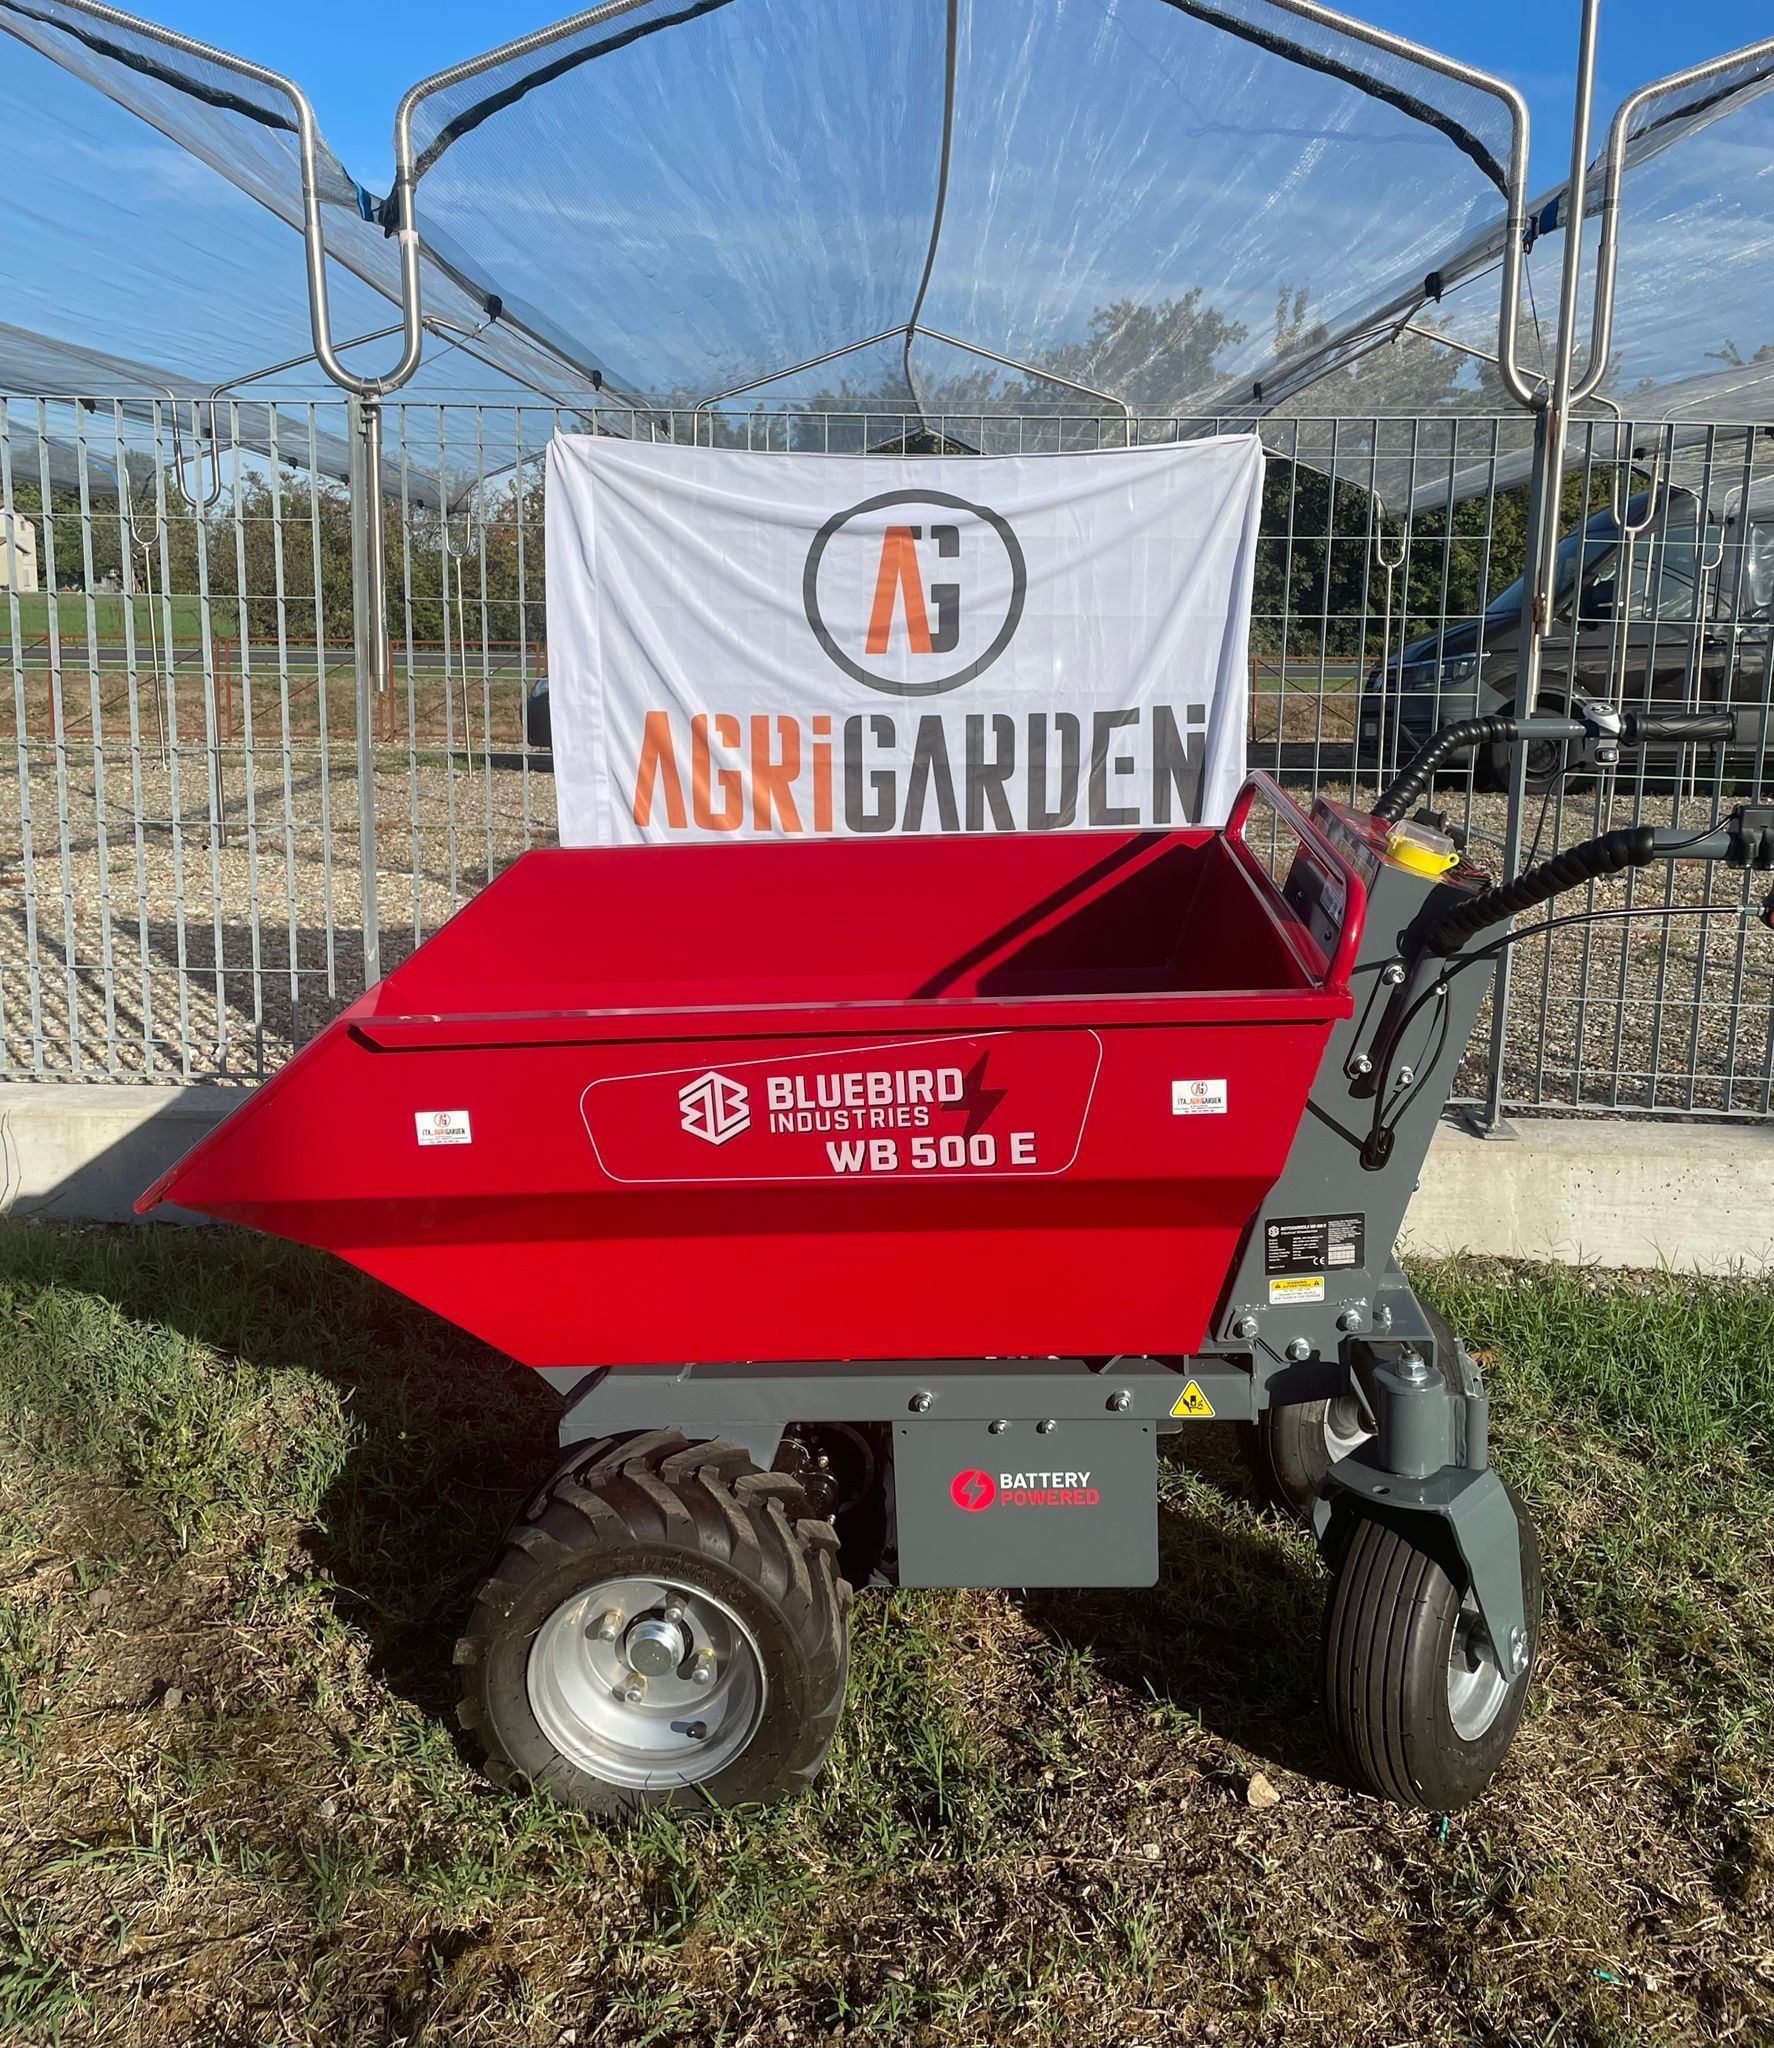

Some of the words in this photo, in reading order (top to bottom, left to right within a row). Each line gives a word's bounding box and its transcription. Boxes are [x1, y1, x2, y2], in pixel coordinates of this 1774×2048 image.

[766, 1068, 964, 1110] BLUEBIRD
[769, 1106, 930, 1133] INDUSTRIES
[826, 1138, 899, 1173] WB
[911, 1133, 996, 1169] 500
[1010, 1131, 1037, 1165] E
[1000, 1472, 1091, 1488] BATTERY
[1001, 1489, 1101, 1507] POWERED
